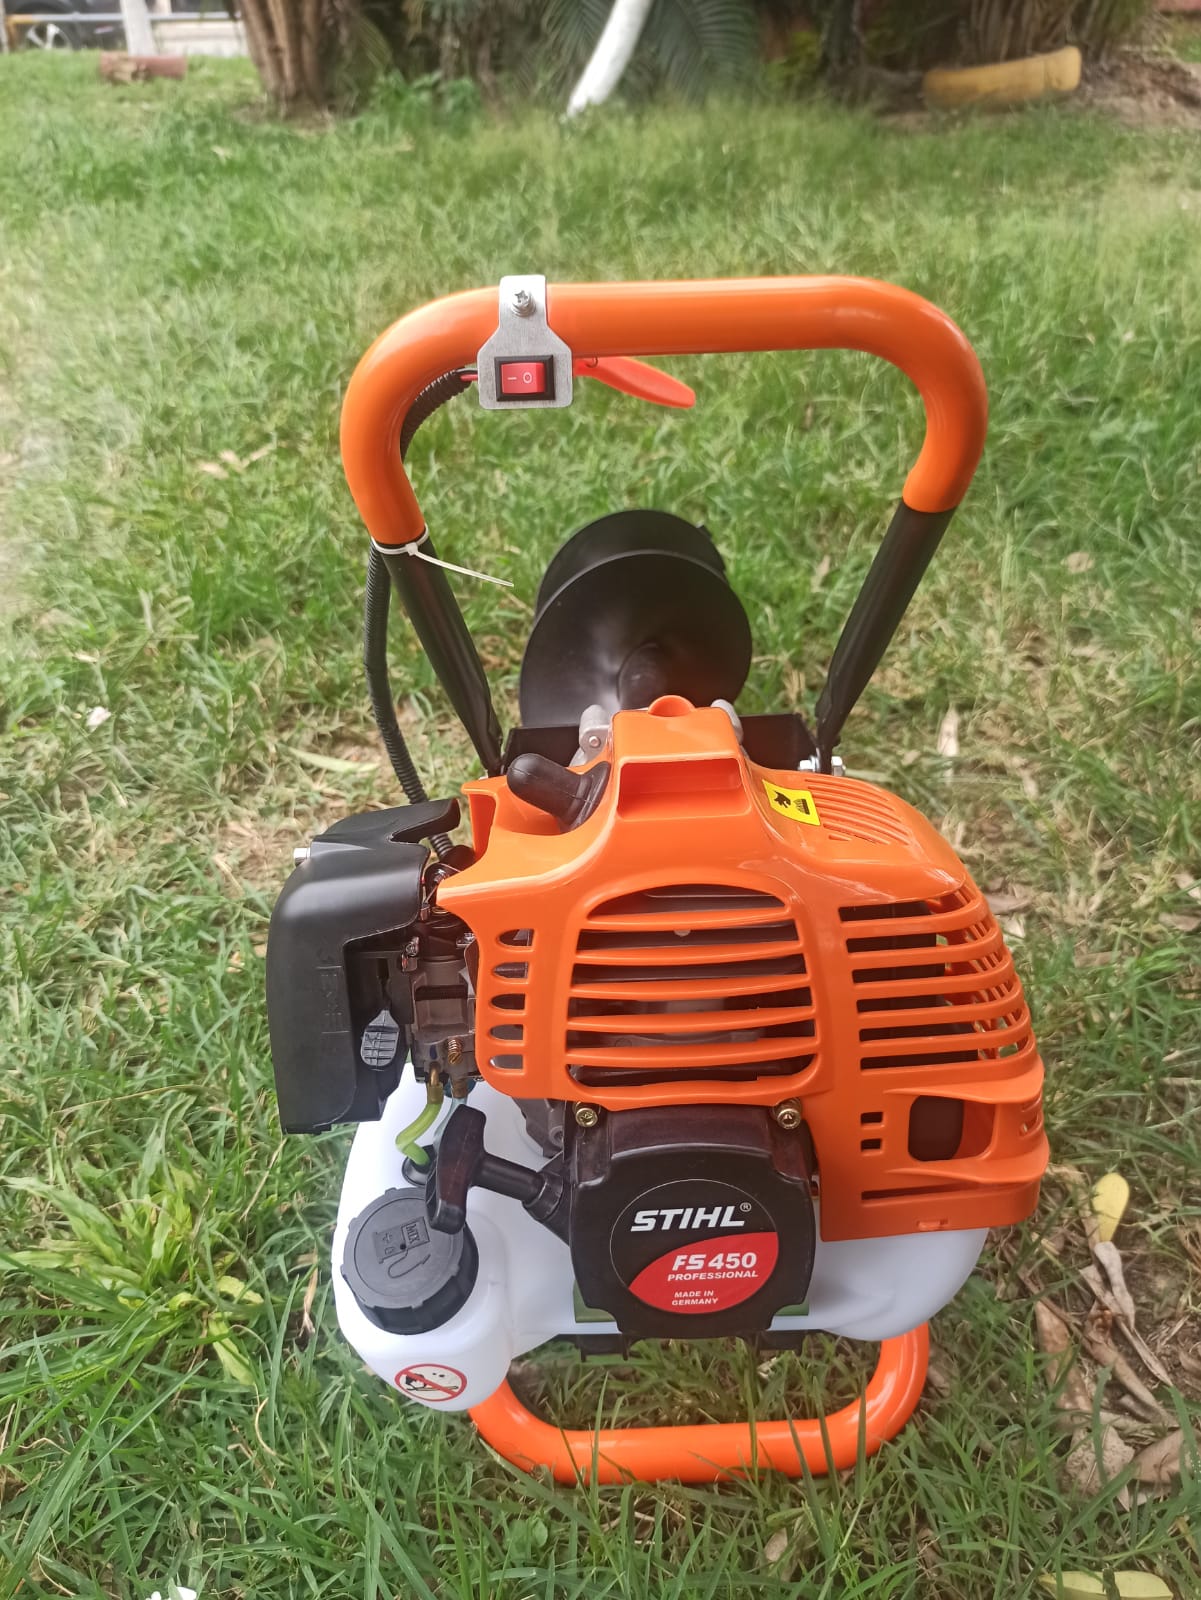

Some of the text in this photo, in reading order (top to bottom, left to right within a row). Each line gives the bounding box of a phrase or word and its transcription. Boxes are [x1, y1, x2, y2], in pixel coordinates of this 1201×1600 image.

[671, 1252, 757, 1271] FS 450
[667, 1270, 759, 1282] PROFESSIONAL
[674, 1290, 701, 1298] MADE
[671, 1298, 719, 1306] GERMANY
